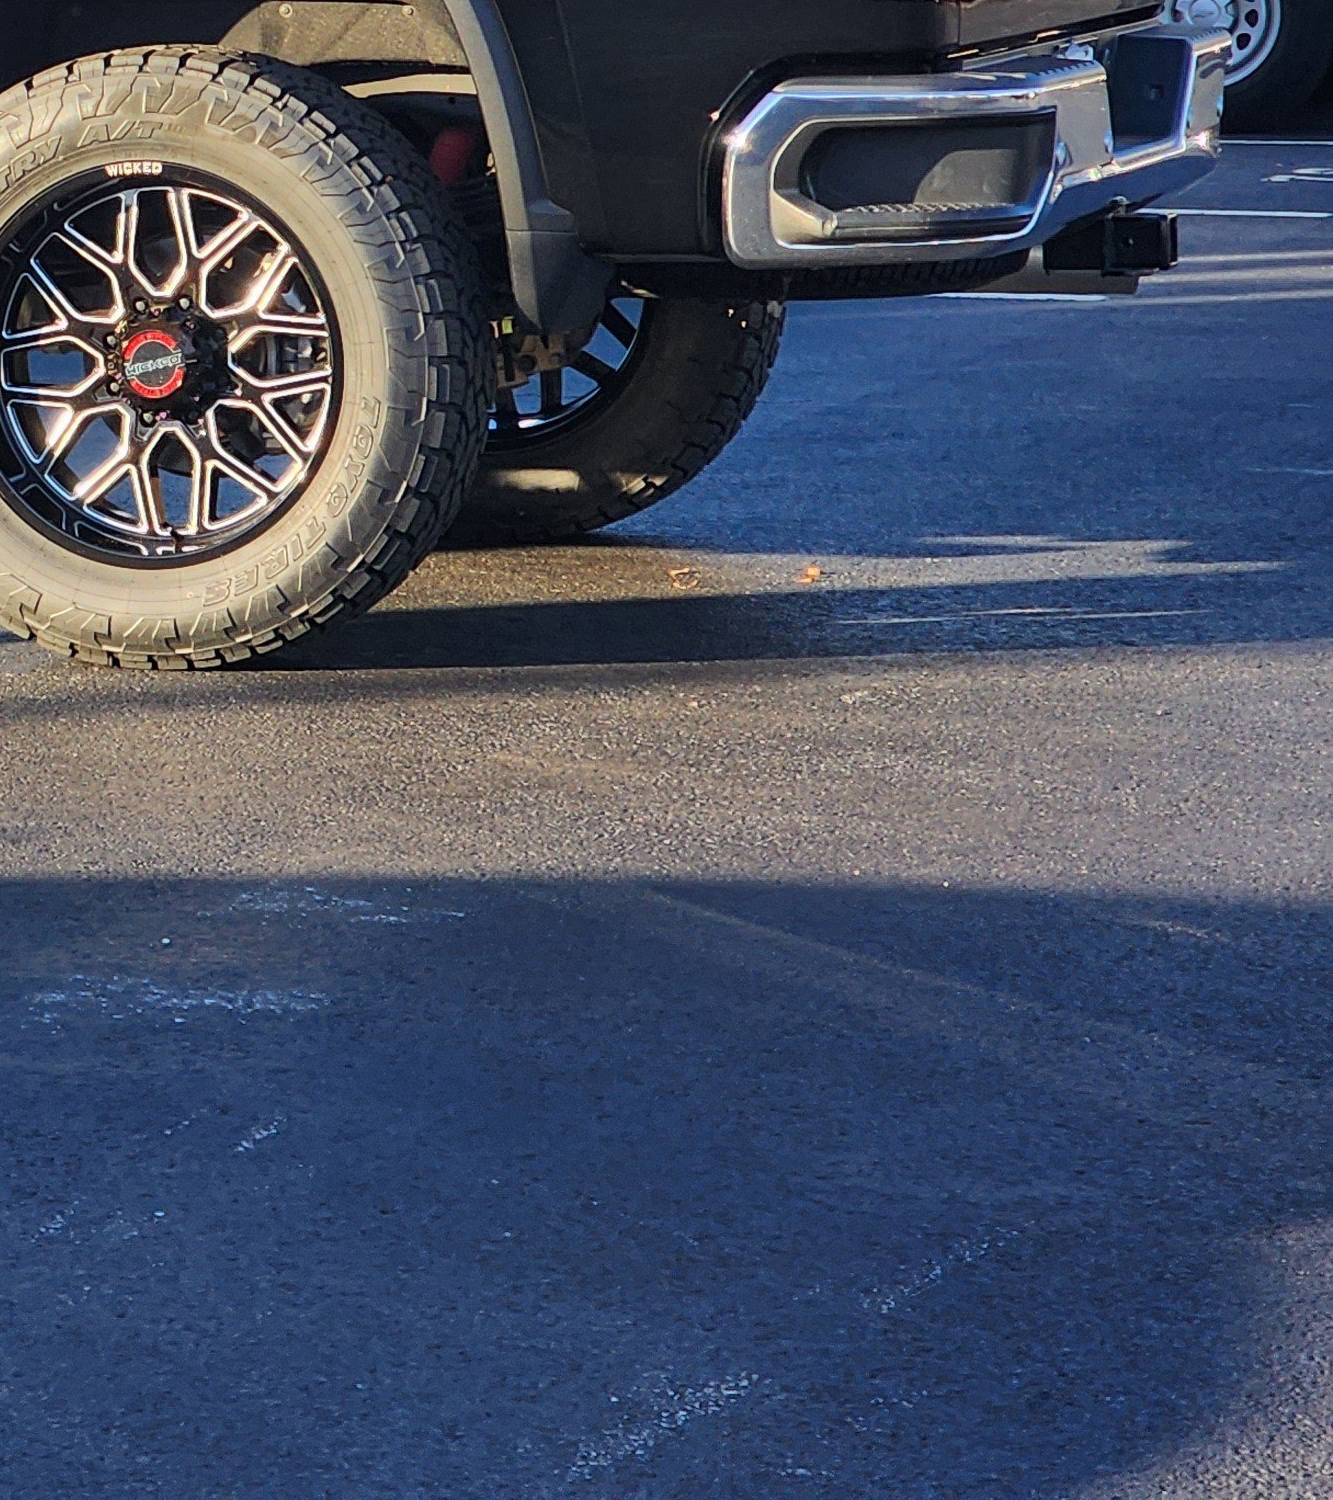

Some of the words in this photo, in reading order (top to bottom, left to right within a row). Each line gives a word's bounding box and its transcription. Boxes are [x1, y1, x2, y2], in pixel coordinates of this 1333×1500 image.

[76, 119, 163, 148] A/T
[104, 161, 163, 177] WICKED
[325, 396, 381, 519] TOYO
[202, 515, 327, 608] TIRES
